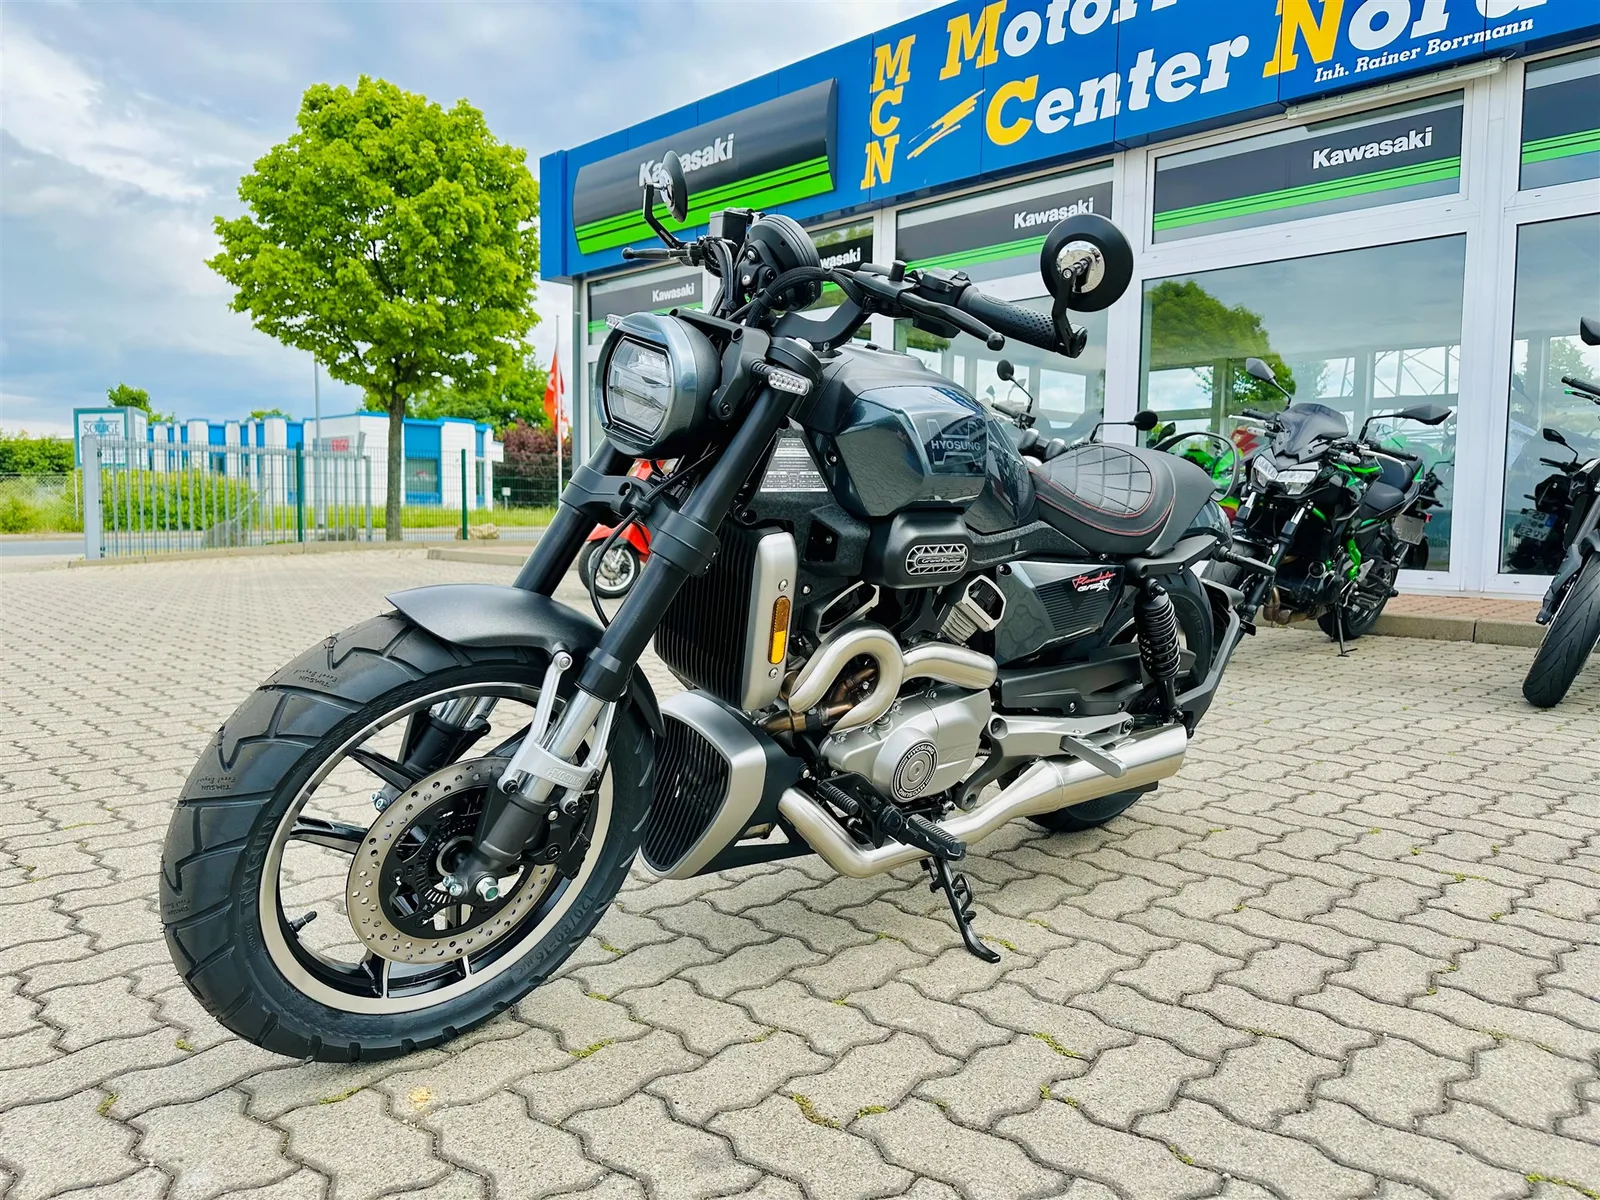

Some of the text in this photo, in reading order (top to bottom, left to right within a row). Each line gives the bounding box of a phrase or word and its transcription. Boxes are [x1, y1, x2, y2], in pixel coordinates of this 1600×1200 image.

[1314, 18, 1534, 83] Inh. Rainer Borrmann
[985, 0, 1547, 146] Center Nor
[639, 133, 734, 187] Kaasaki
[1312, 126, 1433, 169] Kawasaki
[1013, 197, 1094, 230] Kawasaki
[652, 282, 695, 303] Kawasaki
[931, 440, 981, 451] HYOSUNG
